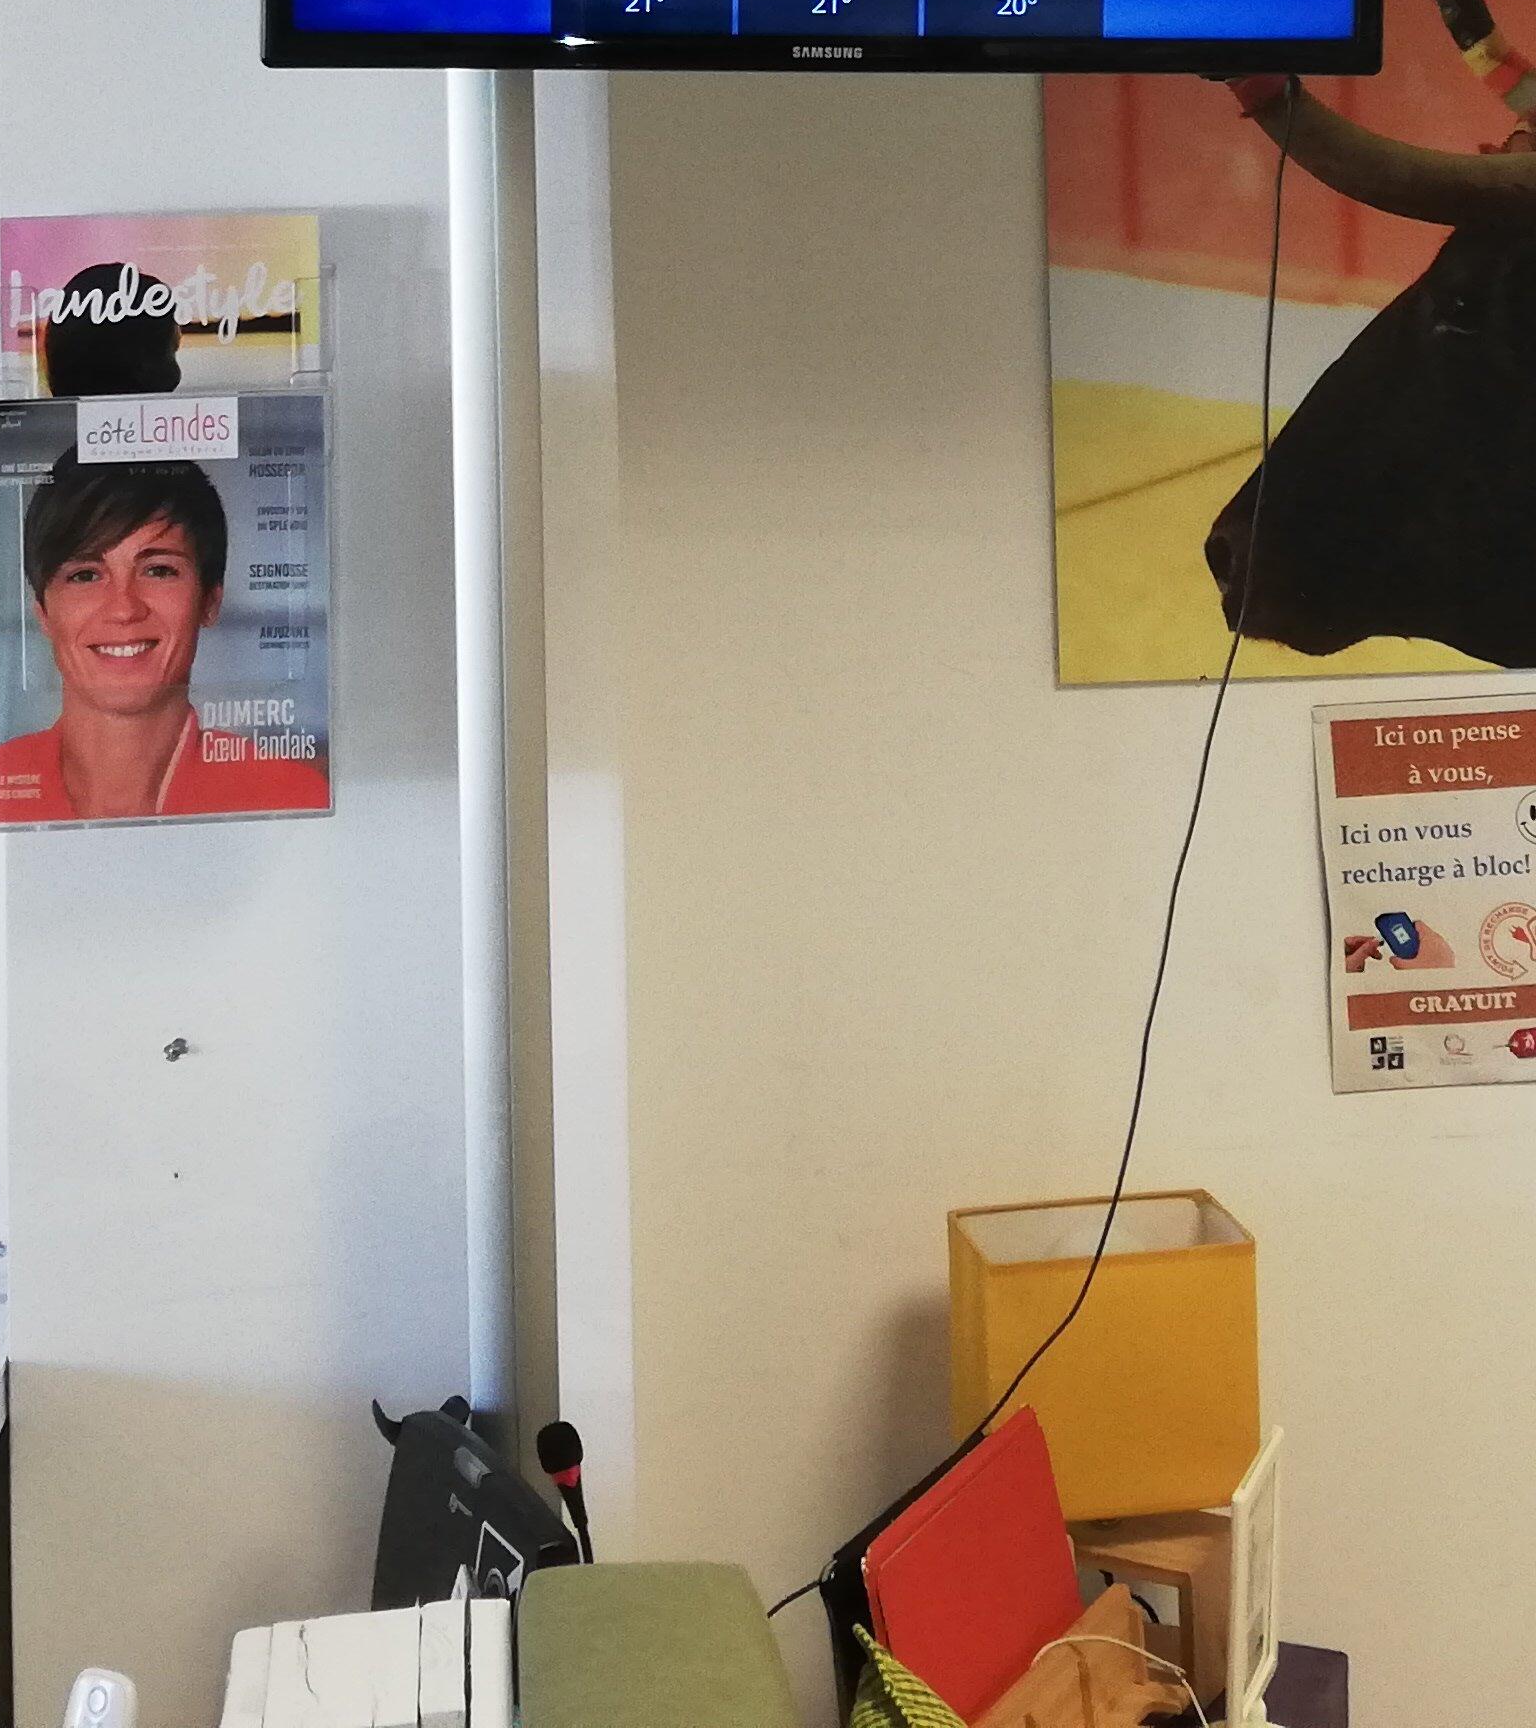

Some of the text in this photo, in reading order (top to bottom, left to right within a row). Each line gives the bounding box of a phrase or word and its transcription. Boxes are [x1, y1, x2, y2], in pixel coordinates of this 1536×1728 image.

[791, 46, 864, 60] SAMSUNG
[9, 261, 302, 345] Landestyle
[85, 403, 231, 445] côté Landes
[249, 563, 309, 578] SEIGNOSSE
[202, 698, 296, 729] DUMERC
[202, 727, 316, 764] Cœur landais
[1374, 723, 1522, 750] Ici on pense
[1408, 764, 1495, 785] à vous,
[1340, 822, 1473, 846] Ici on vous
[1342, 854, 1531, 887] recharge à bloc!
[1409, 991, 1517, 1013] GRATUIT
